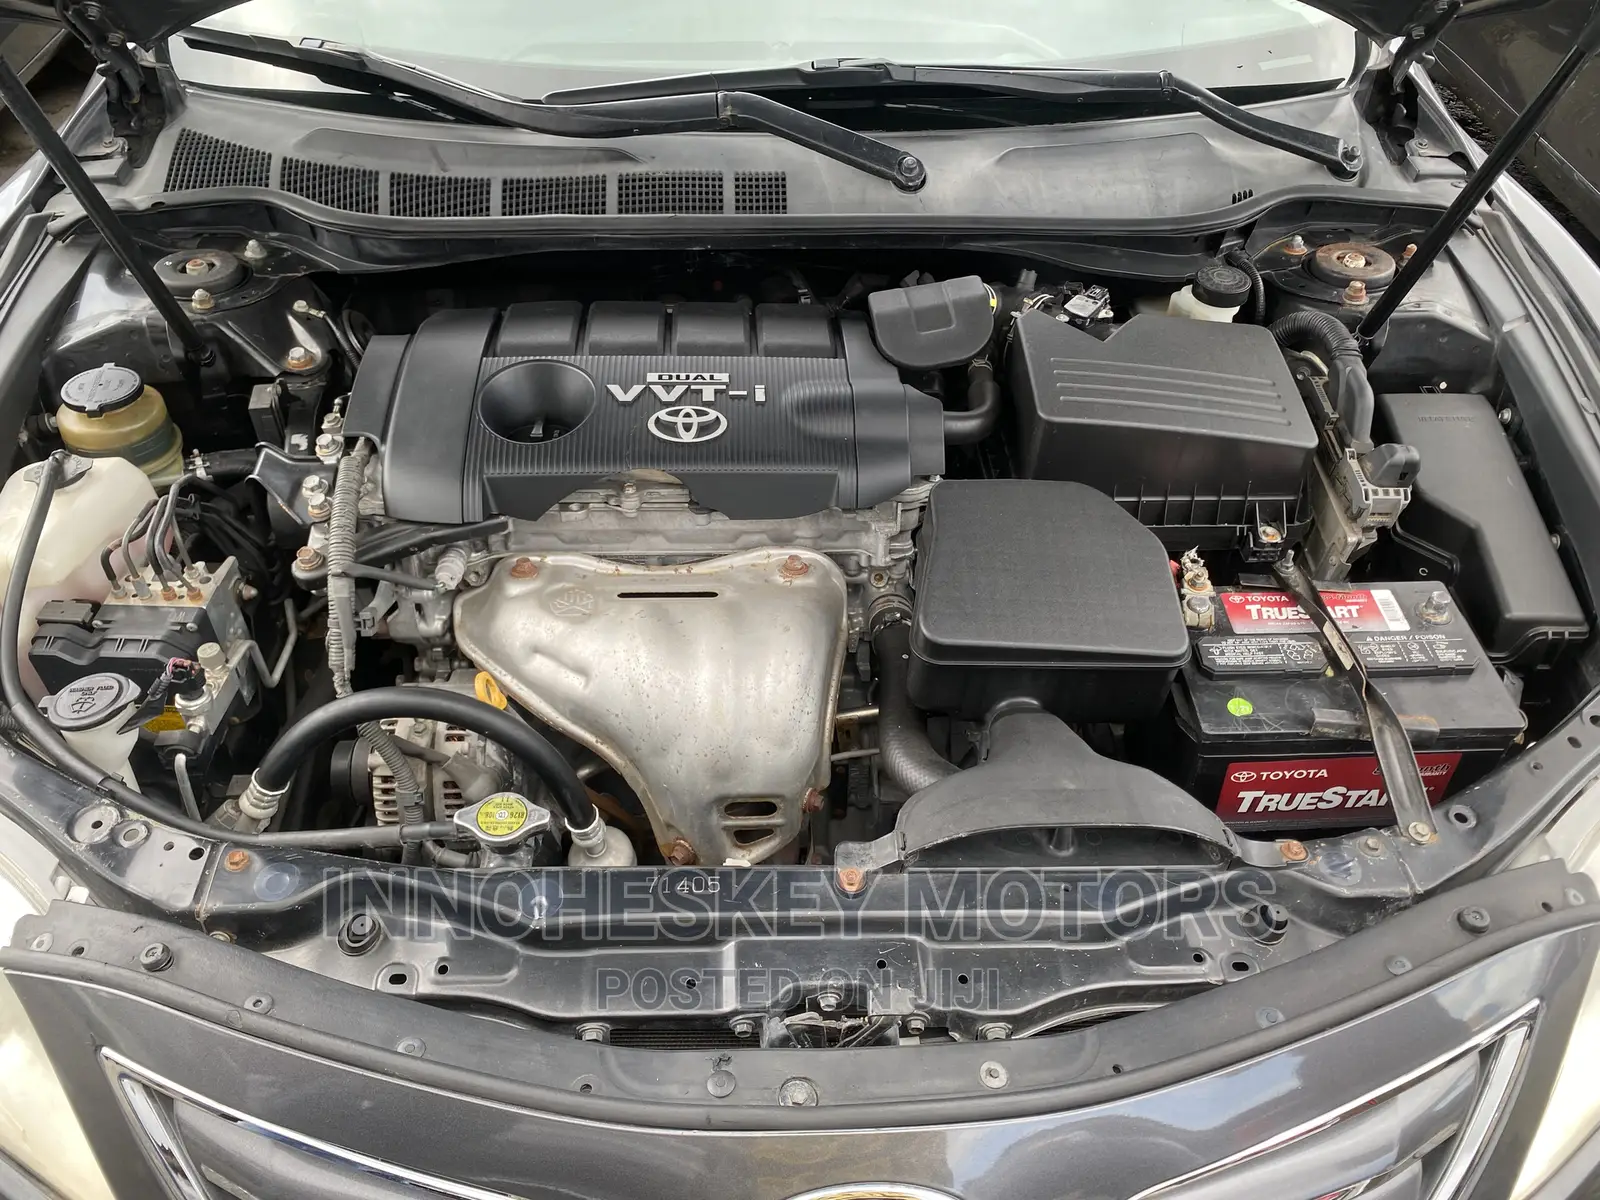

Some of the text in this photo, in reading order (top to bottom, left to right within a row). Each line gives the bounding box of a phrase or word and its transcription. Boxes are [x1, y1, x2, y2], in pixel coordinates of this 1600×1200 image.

[657, 373, 723, 382] DUAL
[606, 384, 767, 402] VVT-i
[1245, 595, 1290, 603] TOYOTA
[1373, 634, 1408, 642] DANGER
[1414, 633, 1447, 641] POISON
[1259, 768, 1329, 781] TOYOTA
[645, 875, 721, 894] 71405
